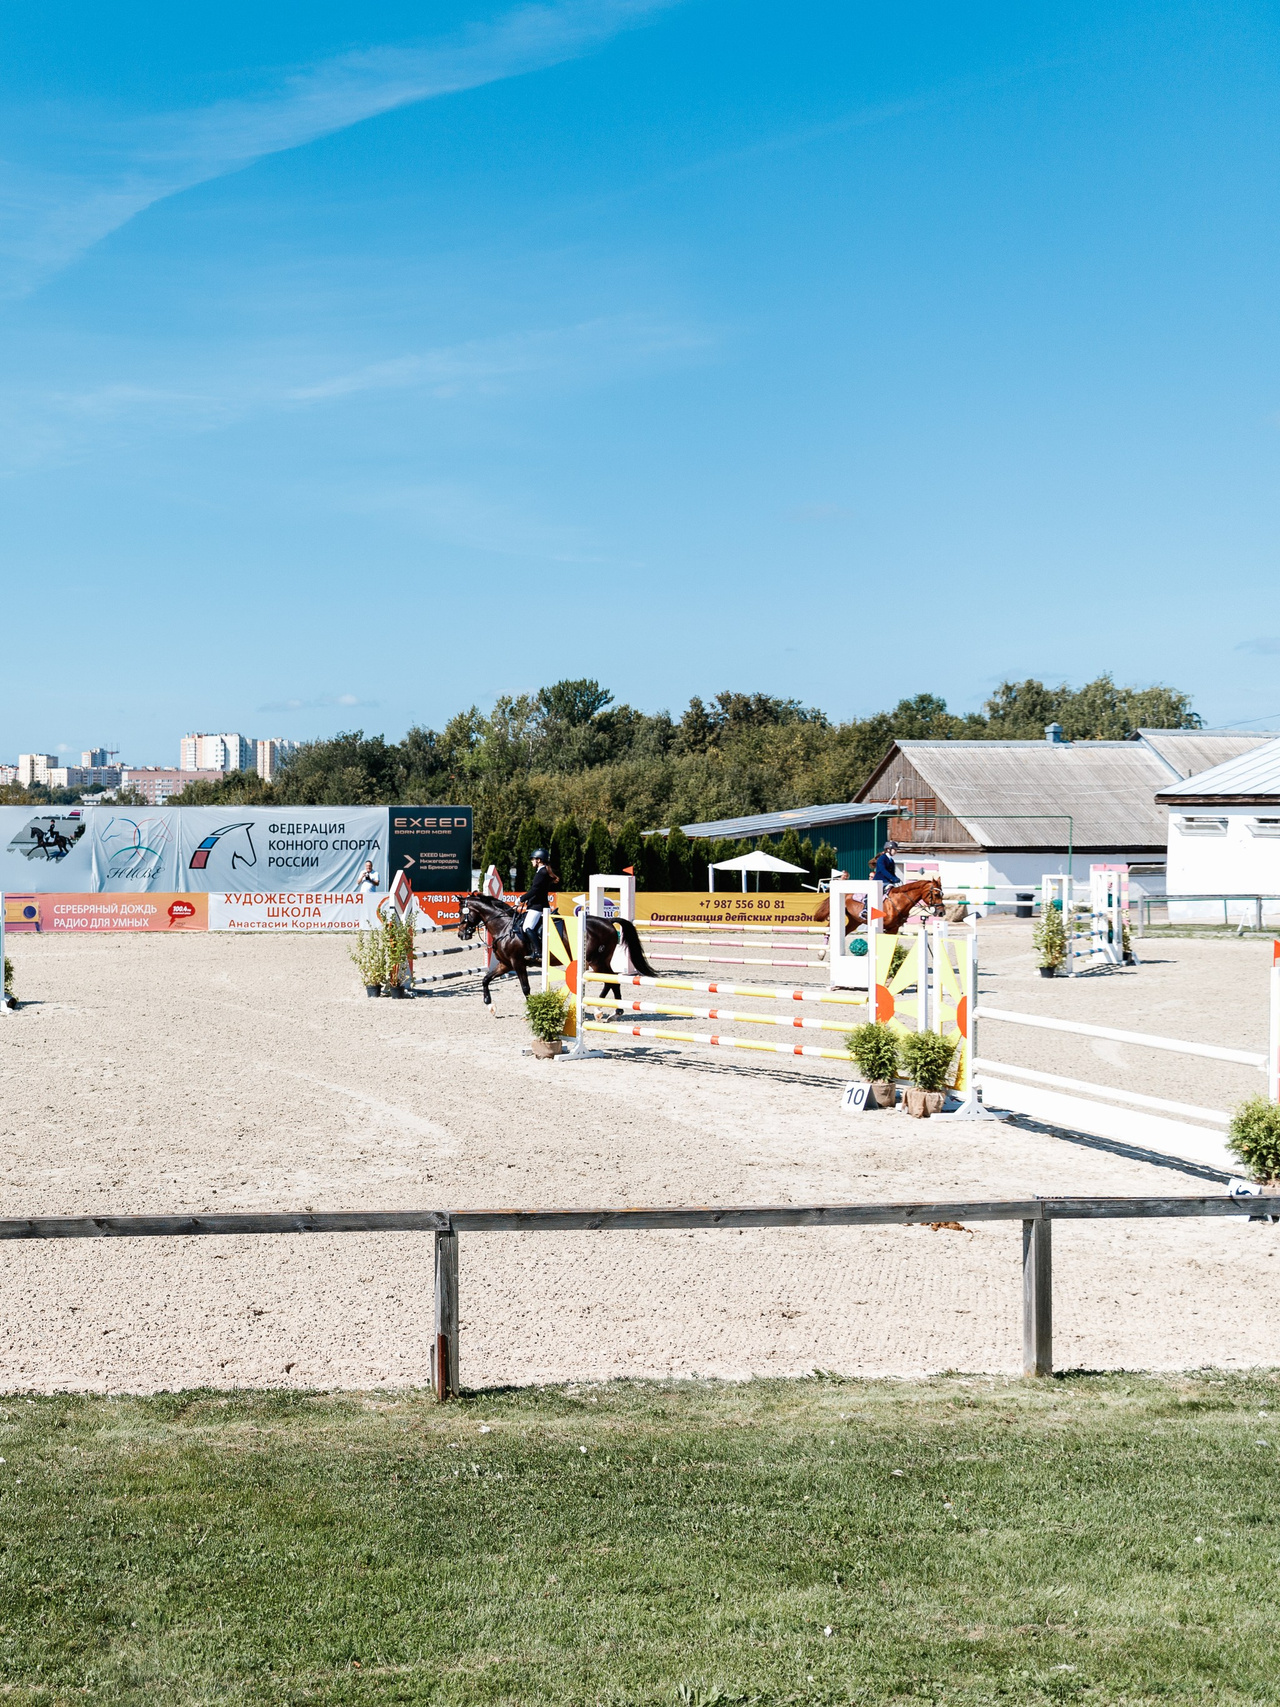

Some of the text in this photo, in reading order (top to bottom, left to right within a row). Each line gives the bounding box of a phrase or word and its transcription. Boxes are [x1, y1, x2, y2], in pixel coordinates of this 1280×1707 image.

[394, 818, 467, 828] EXEED
[268, 823, 346, 835] ФЕДЕРАЦИЯ
[268, 839, 380, 850] КОННОГО СПОРТА
[268, 856, 319, 868] РОССИИ
[224, 894, 364, 906] ХУДОЖЕСТВЕННАЯ
[422, 895, 450, 904] +7(831)
[700, 900, 784, 908] +7 987 556 80 81
[54, 904, 157, 915] СЕРЕБРЯНЫЙ ДОЖДЬ
[267, 907, 322, 918] ШКОЛА
[651, 913, 723, 922] Организация
[725, 912, 772, 921] детских
[54, 918, 149, 928] РАДИО ДЛЯ УМНЫХ
[228, 920, 360, 930] Анастасии Корниловой
[847, 1087, 864, 1105] 10
